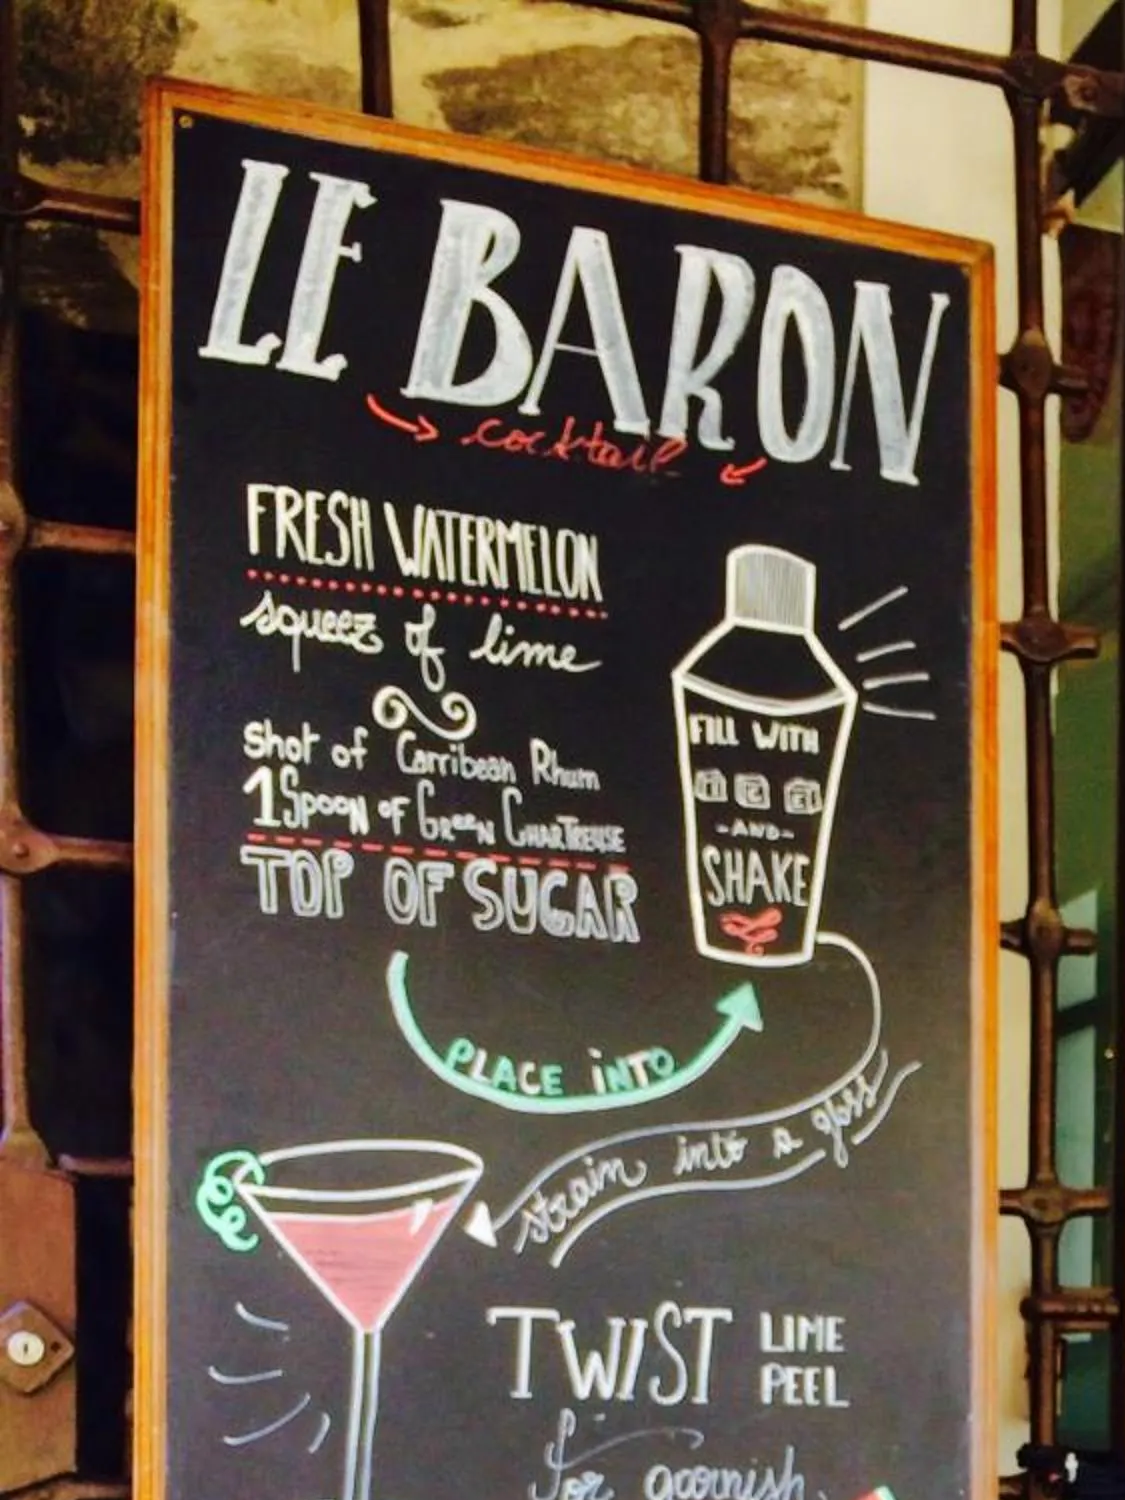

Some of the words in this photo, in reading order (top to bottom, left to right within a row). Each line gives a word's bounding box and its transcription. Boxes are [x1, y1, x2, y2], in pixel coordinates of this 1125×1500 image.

[199, 158, 378, 381] LE
[400, 198, 950, 487] BARON
[460, 415, 688, 474] cocktail
[246, 483, 376, 572] FRESH
[383, 500, 604, 602] WATERMELON
[405, 603, 446, 693] of
[468, 612, 604, 672] lime
[331, 726, 369, 771] of
[529, 737, 602, 792] Rhum
[689, 713, 740, 747] FILL
[751, 719, 820, 755] WITH
[239, 844, 355, 919] TOP
[383, 858, 456, 928] OF
[463, 857, 642, 943] SUGAR
[701, 849, 811, 909] SHAKE
[444, 1037, 564, 1097] PLACE
[514, 1150, 647, 1255] strain
[672, 1134, 748, 1176] into
[486, 1300, 734, 1406] TWIST
[759, 1311, 847, 1354] LIME
[760, 1361, 851, 1408] PEEL
